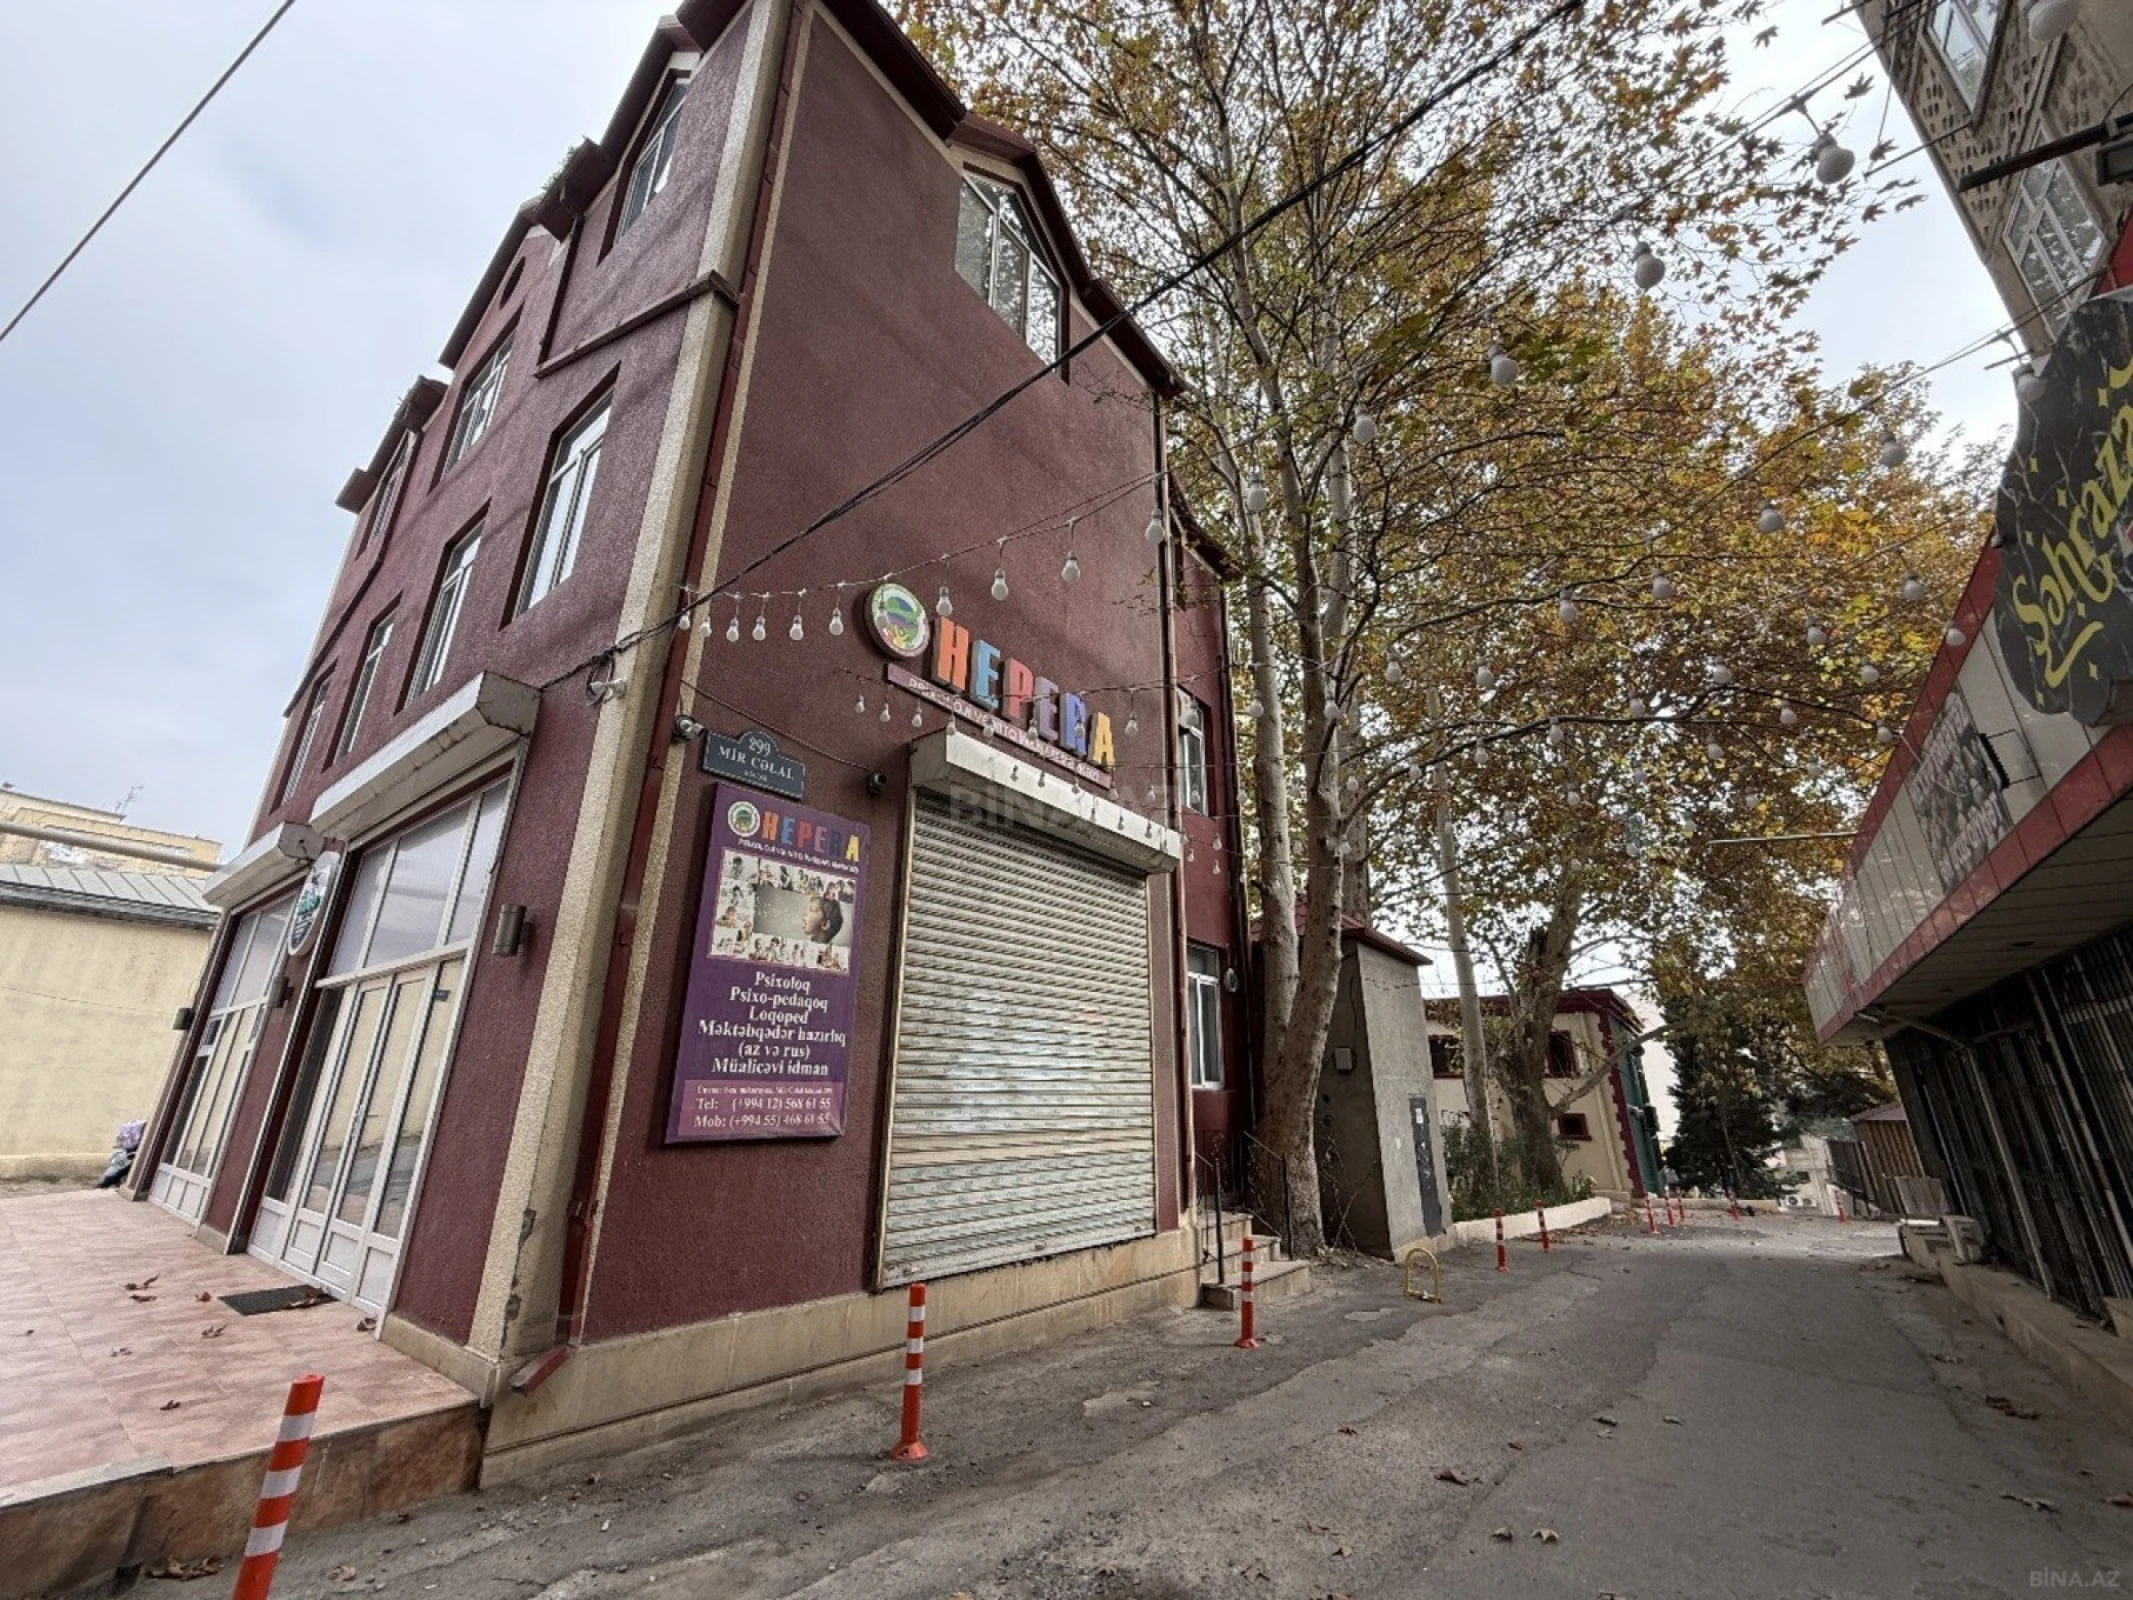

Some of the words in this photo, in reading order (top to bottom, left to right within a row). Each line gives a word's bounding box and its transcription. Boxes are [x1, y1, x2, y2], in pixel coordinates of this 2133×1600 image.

[932, 616, 1114, 770] HEPERA
[748, 736, 771, 757] 299
[718, 745, 746, 763] MİR
[751, 757, 794, 781] CƏLAL
[761, 811, 860, 862] HEPERA
[754, 971, 811, 995] Psixoloq
[729, 987, 828, 1013] Psixo-pedaqoq
[749, 1006, 809, 1026] Loqoped
[738, 1040, 760, 1057] (az
[765, 1044, 779, 1056] və
[783, 1045, 811, 1060] rus)
[788, 1060, 829, 1075] idman
[696, 1098, 719, 1109] Tel:
[819, 1098, 831, 1109] 55
[694, 1114, 726, 1128] Mob:
